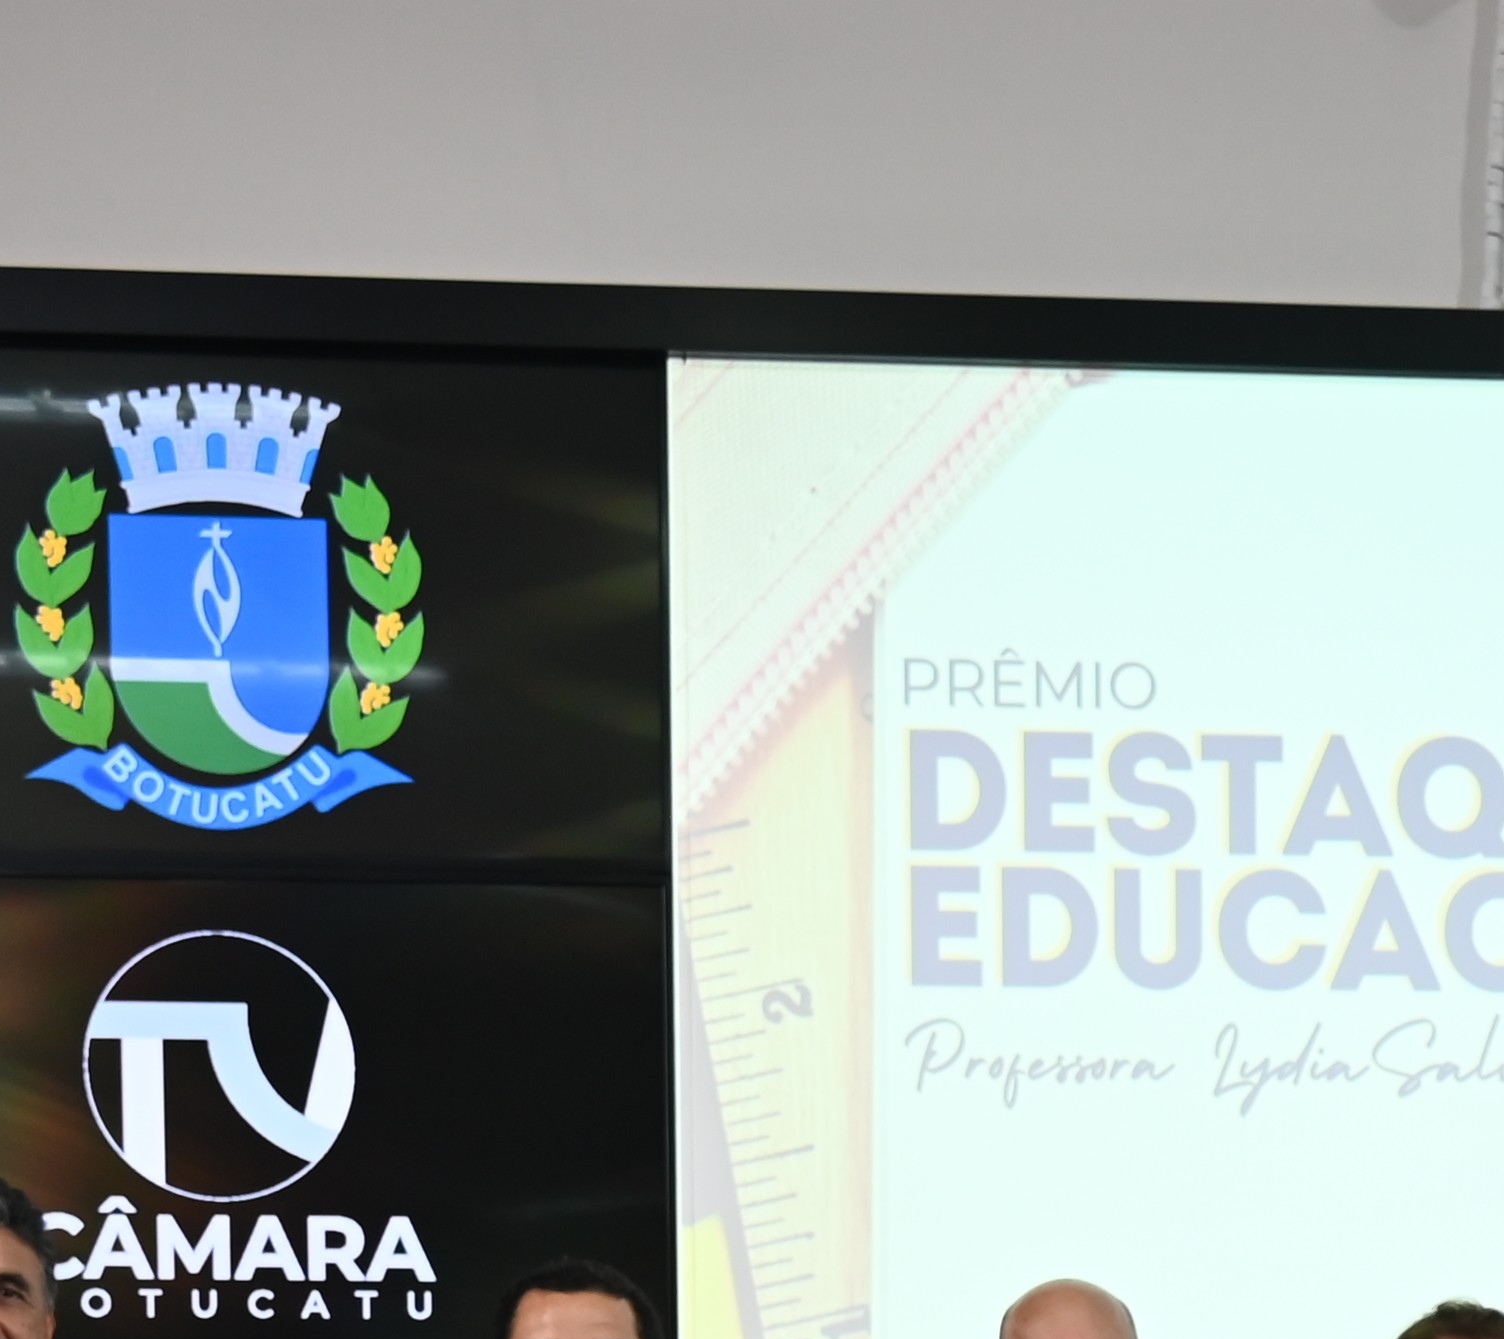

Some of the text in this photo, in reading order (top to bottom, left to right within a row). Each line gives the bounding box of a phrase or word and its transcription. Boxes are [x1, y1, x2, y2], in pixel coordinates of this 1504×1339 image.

[902, 646, 1158, 710] PRÊMIO
[99, 745, 334, 825] BOTUCATU
[905, 1017, 1175, 1109] Professora
[1213, 1021, 1370, 1117] Lydia
[41, 1195, 437, 1283] CÂMARA
[80, 1287, 434, 1321] OTUCATU
